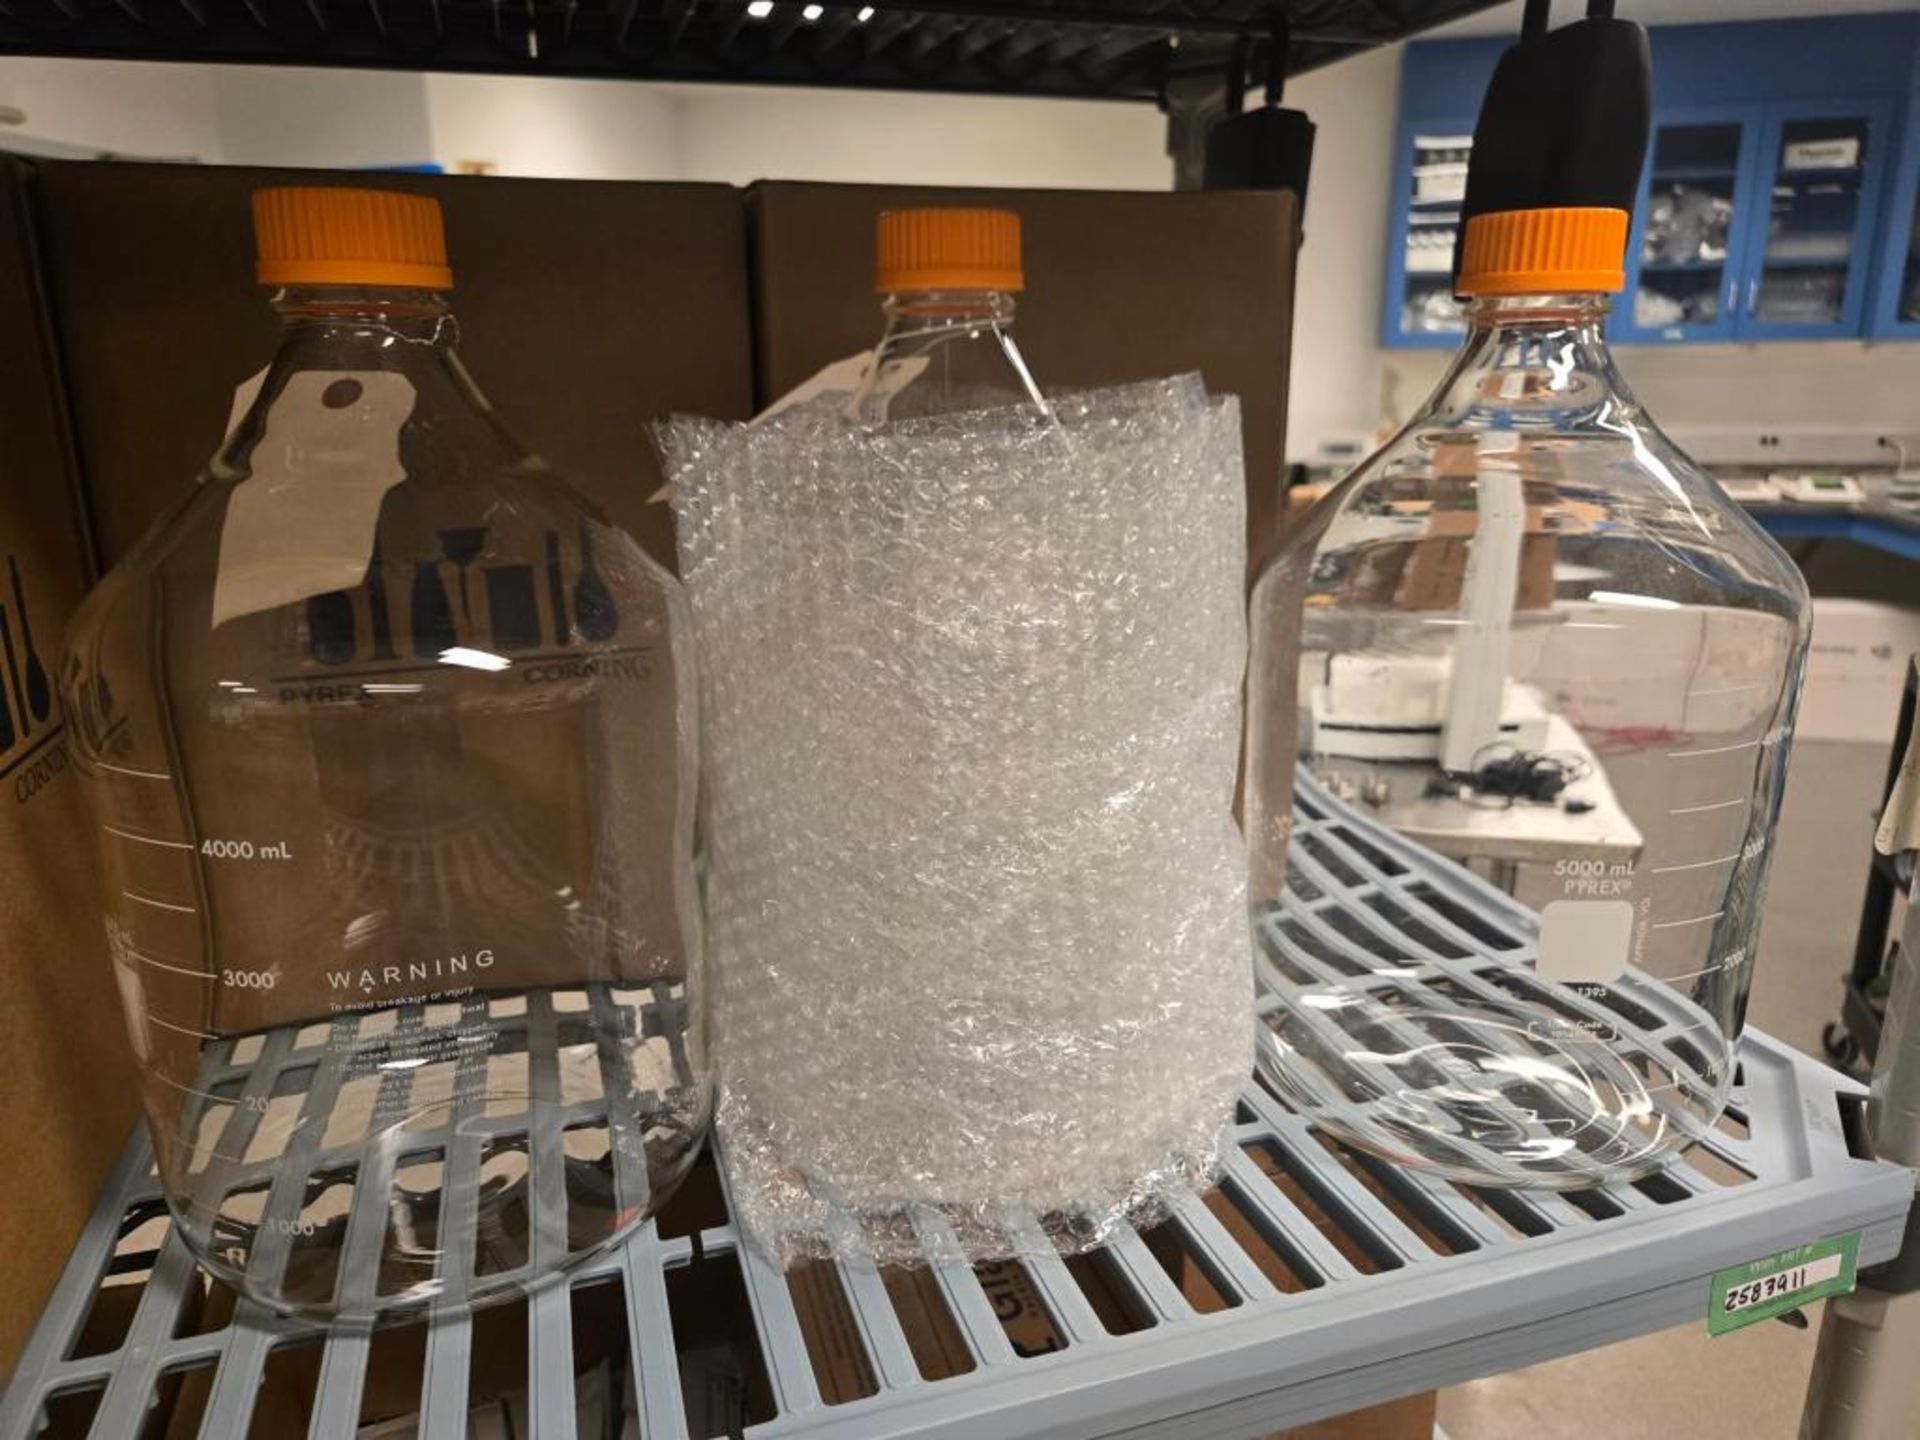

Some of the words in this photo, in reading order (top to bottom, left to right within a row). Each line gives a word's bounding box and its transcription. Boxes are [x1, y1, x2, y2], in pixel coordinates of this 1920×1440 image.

[523, 656, 649, 684] CORNING
[201, 839, 254, 859] 4000
[260, 841, 293, 859] mL
[1553, 859, 1605, 876] 5000
[1609, 860, 1636, 875] mL
[223, 969, 275, 989] 3000
[326, 950, 495, 989] WARNING
[269, 1218, 315, 1237] 1000
